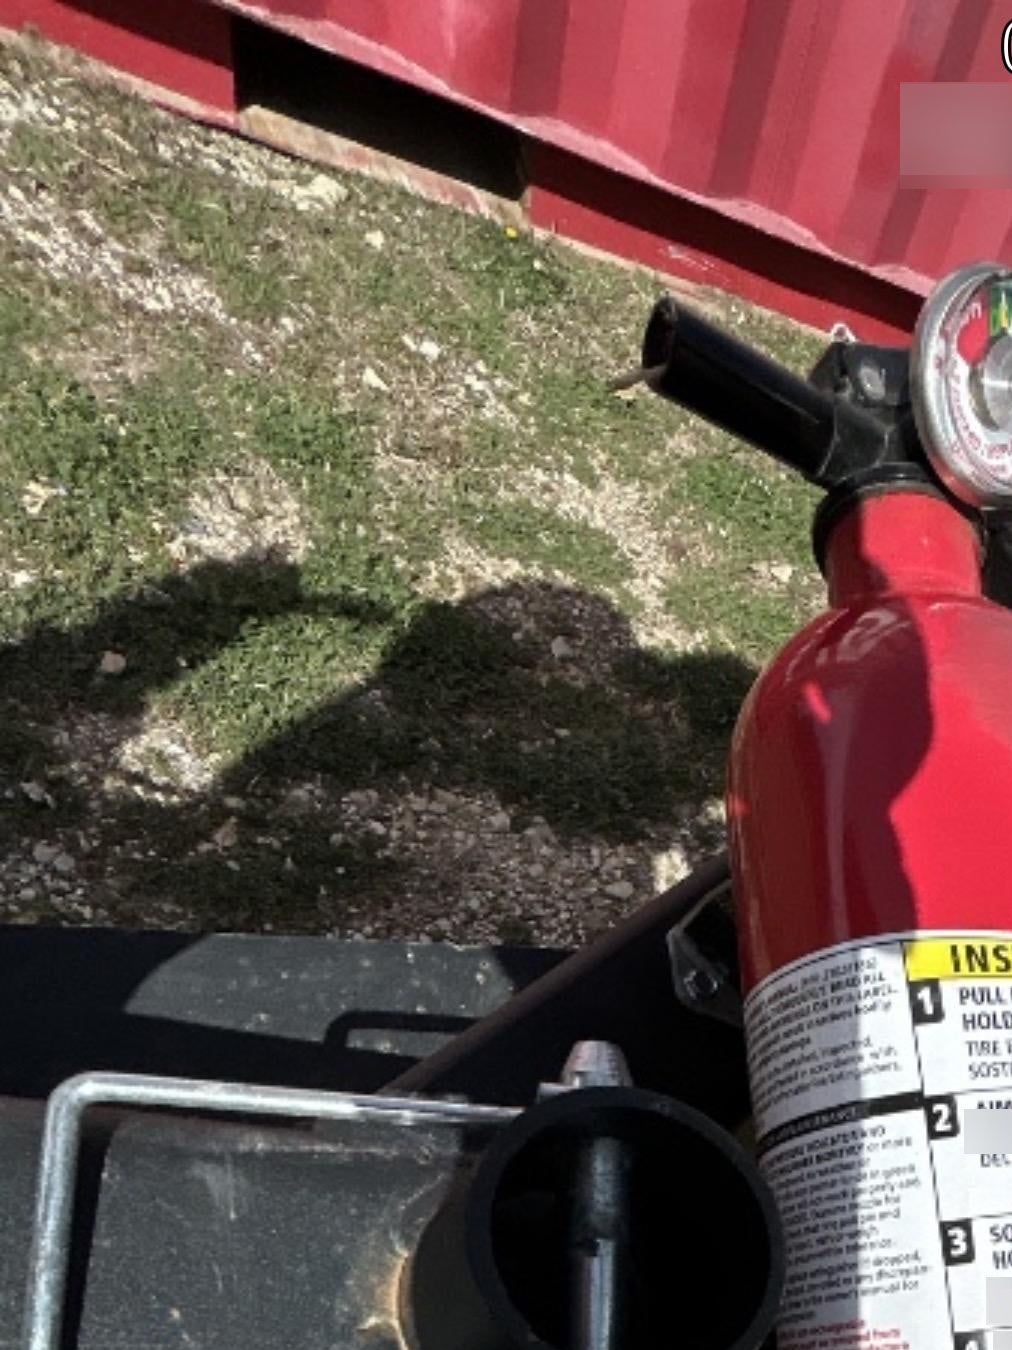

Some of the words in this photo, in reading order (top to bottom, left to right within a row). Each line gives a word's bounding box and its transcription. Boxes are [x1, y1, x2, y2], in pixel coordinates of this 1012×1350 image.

[917, 986, 935, 1016] 1
[959, 986, 1004, 1006] PULL
[931, 1103, 953, 1133] 2
[946, 1226, 968, 1257] 3
